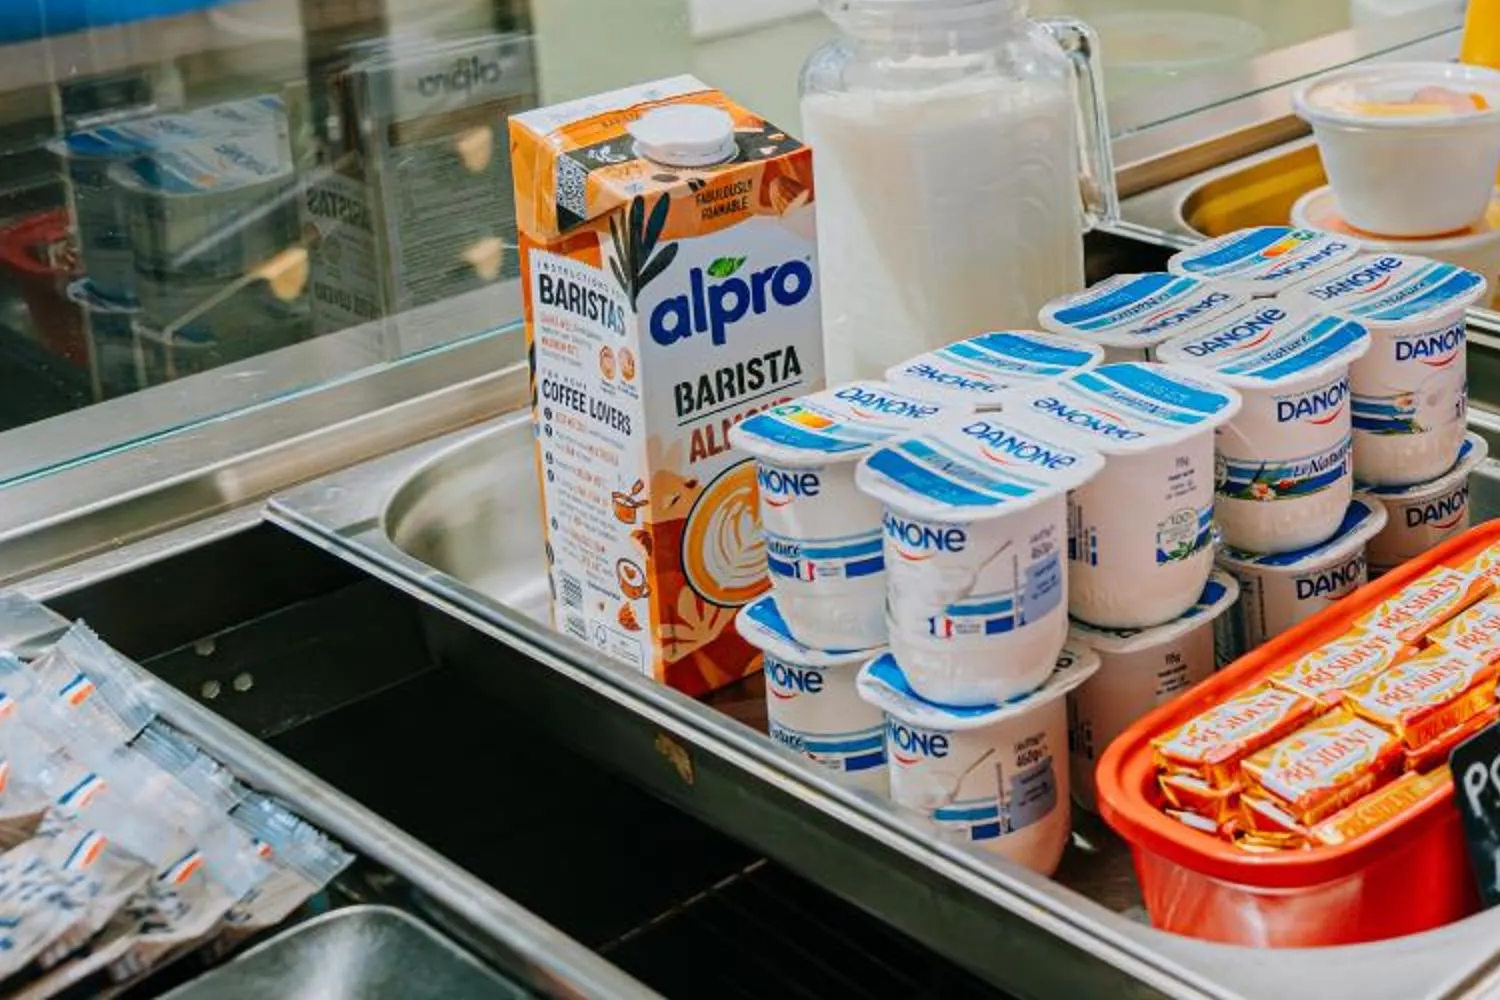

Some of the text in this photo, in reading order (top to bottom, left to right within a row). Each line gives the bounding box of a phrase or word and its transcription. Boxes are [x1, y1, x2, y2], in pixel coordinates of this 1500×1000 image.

[539, 273, 625, 336] BARISTAS
[650, 258, 813, 346] alpro
[542, 378, 587, 414] COFFEE
[589, 397, 632, 436] LOVERS
[674, 345, 802, 417] BARISTA
